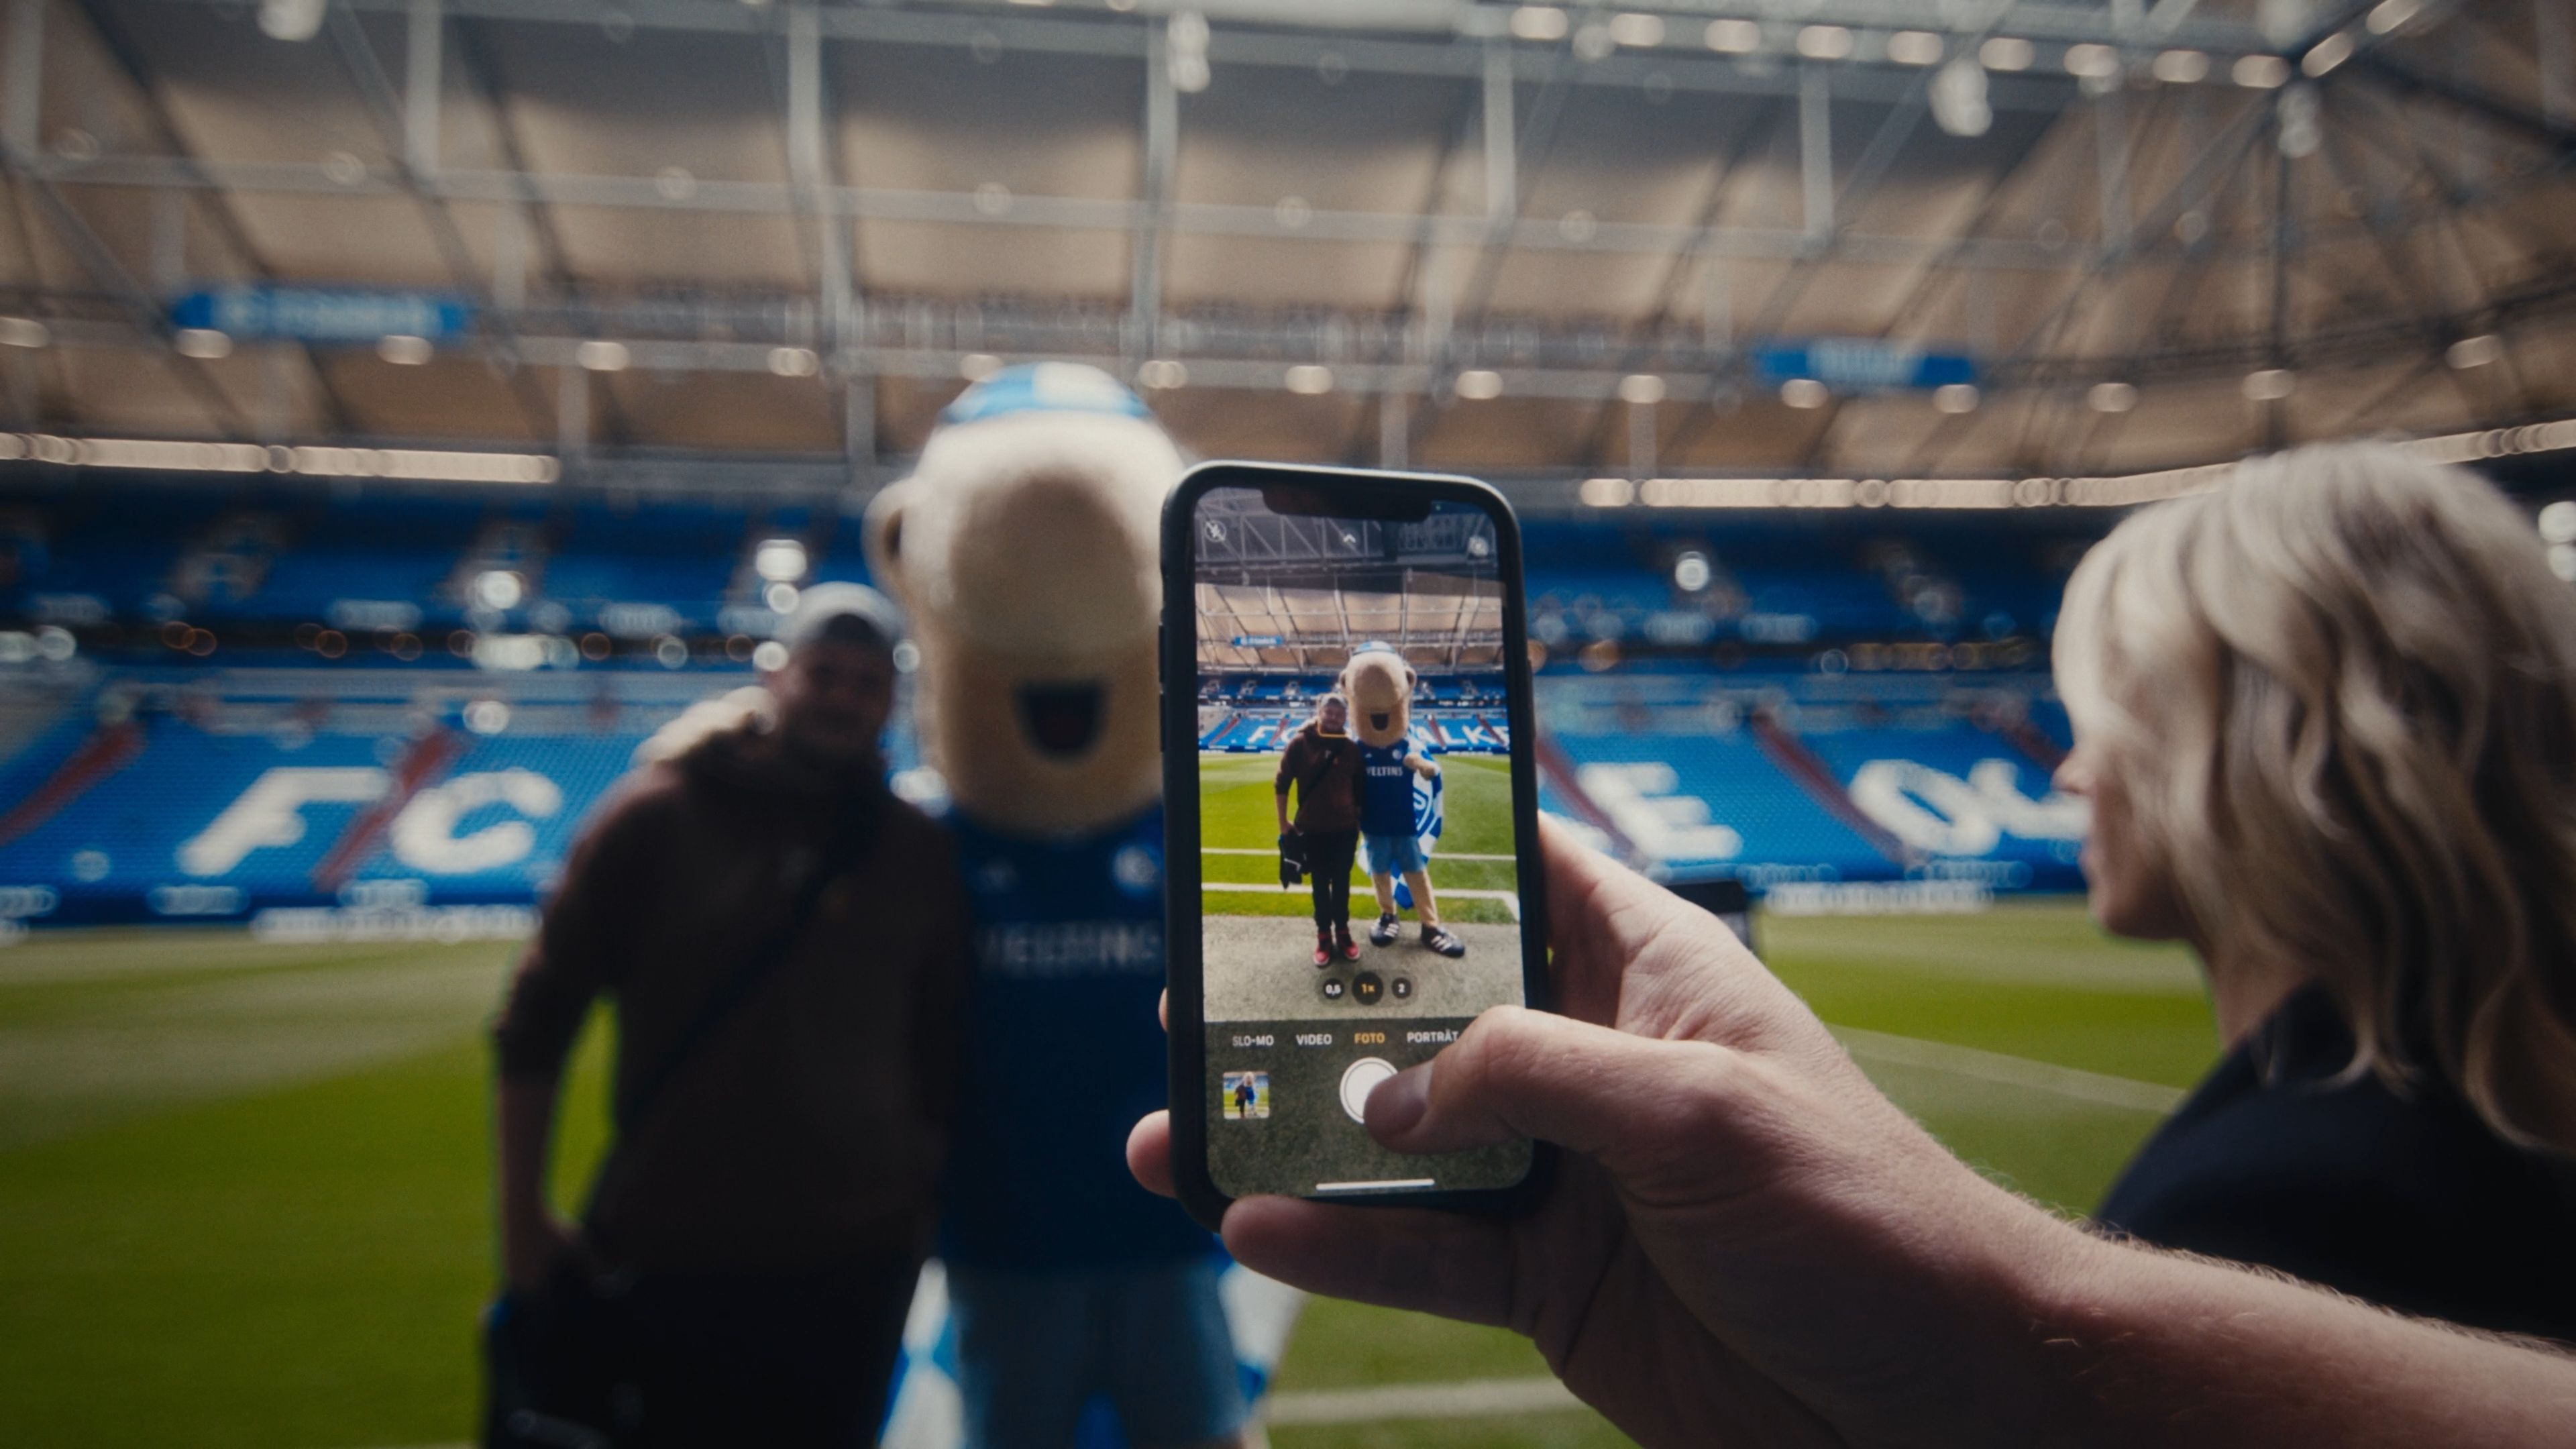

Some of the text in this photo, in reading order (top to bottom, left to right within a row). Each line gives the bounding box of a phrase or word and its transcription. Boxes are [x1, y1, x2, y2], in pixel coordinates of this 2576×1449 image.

[1366, 766, 1403, 776] VELTINS
[176, 767, 562, 876] FC
[1398, 983, 1405, 993] 2
[1232, 1035, 1274, 1046] SLO-MO
[1296, 1034, 1332, 1045] VIDEO
[1354, 1033, 1385, 1044] FOTO
